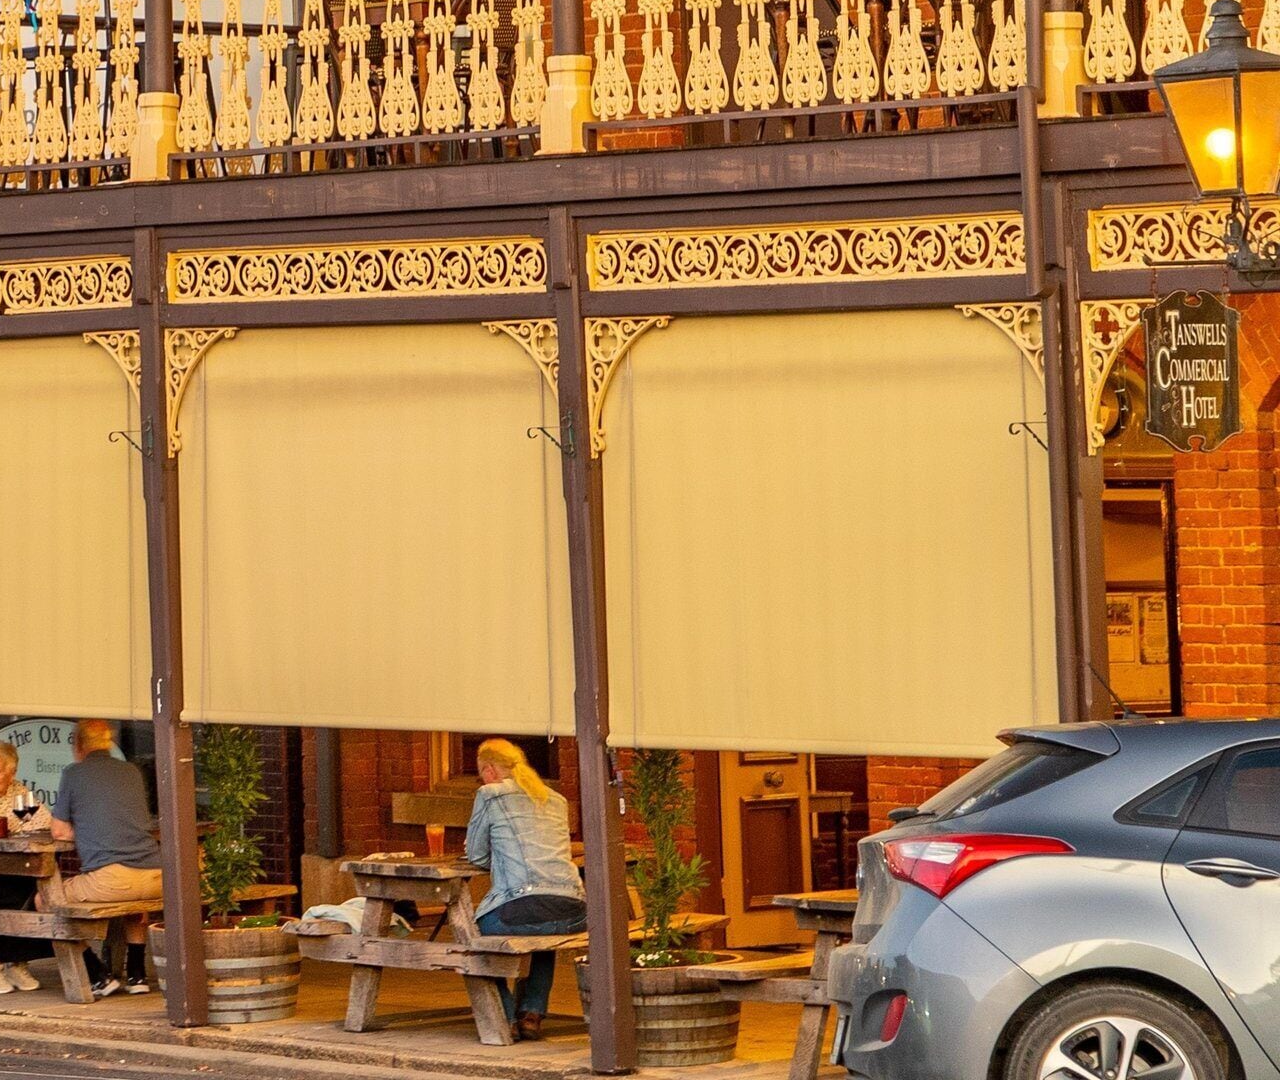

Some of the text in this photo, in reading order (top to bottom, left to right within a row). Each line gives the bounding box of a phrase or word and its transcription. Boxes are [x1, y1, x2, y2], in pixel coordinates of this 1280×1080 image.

[1165, 310, 1227, 352] TANSWELLS
[1156, 346, 1230, 389] COMMERCIAL
[1181, 384, 1220, 427] HOTEL
